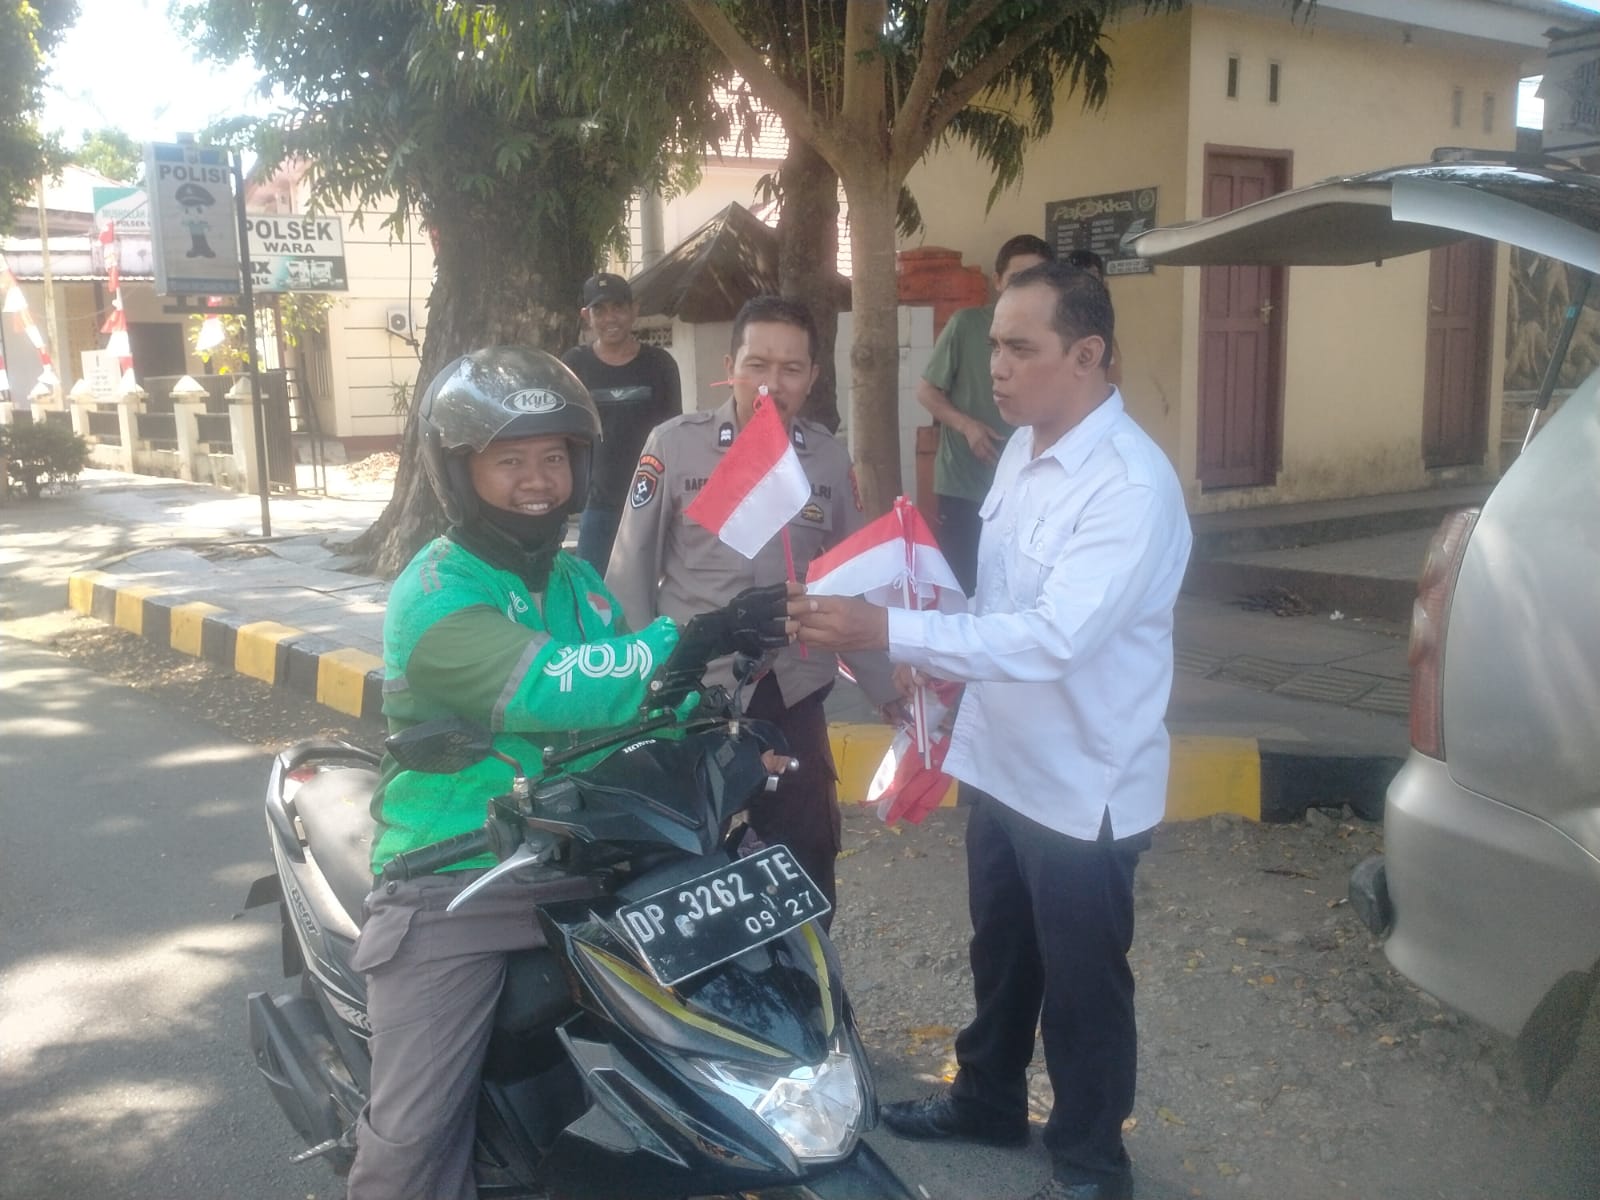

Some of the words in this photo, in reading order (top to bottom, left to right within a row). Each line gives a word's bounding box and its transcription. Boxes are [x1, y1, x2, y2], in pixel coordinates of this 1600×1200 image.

[159, 164, 227, 184] POLISI
[263, 242, 315, 253] WARA
[626, 904, 665, 943] DP
[679, 873, 754, 920] 3262
[756, 853, 799, 886] TE
[745, 910, 776, 934] 09
[785, 891, 814, 916] 27
